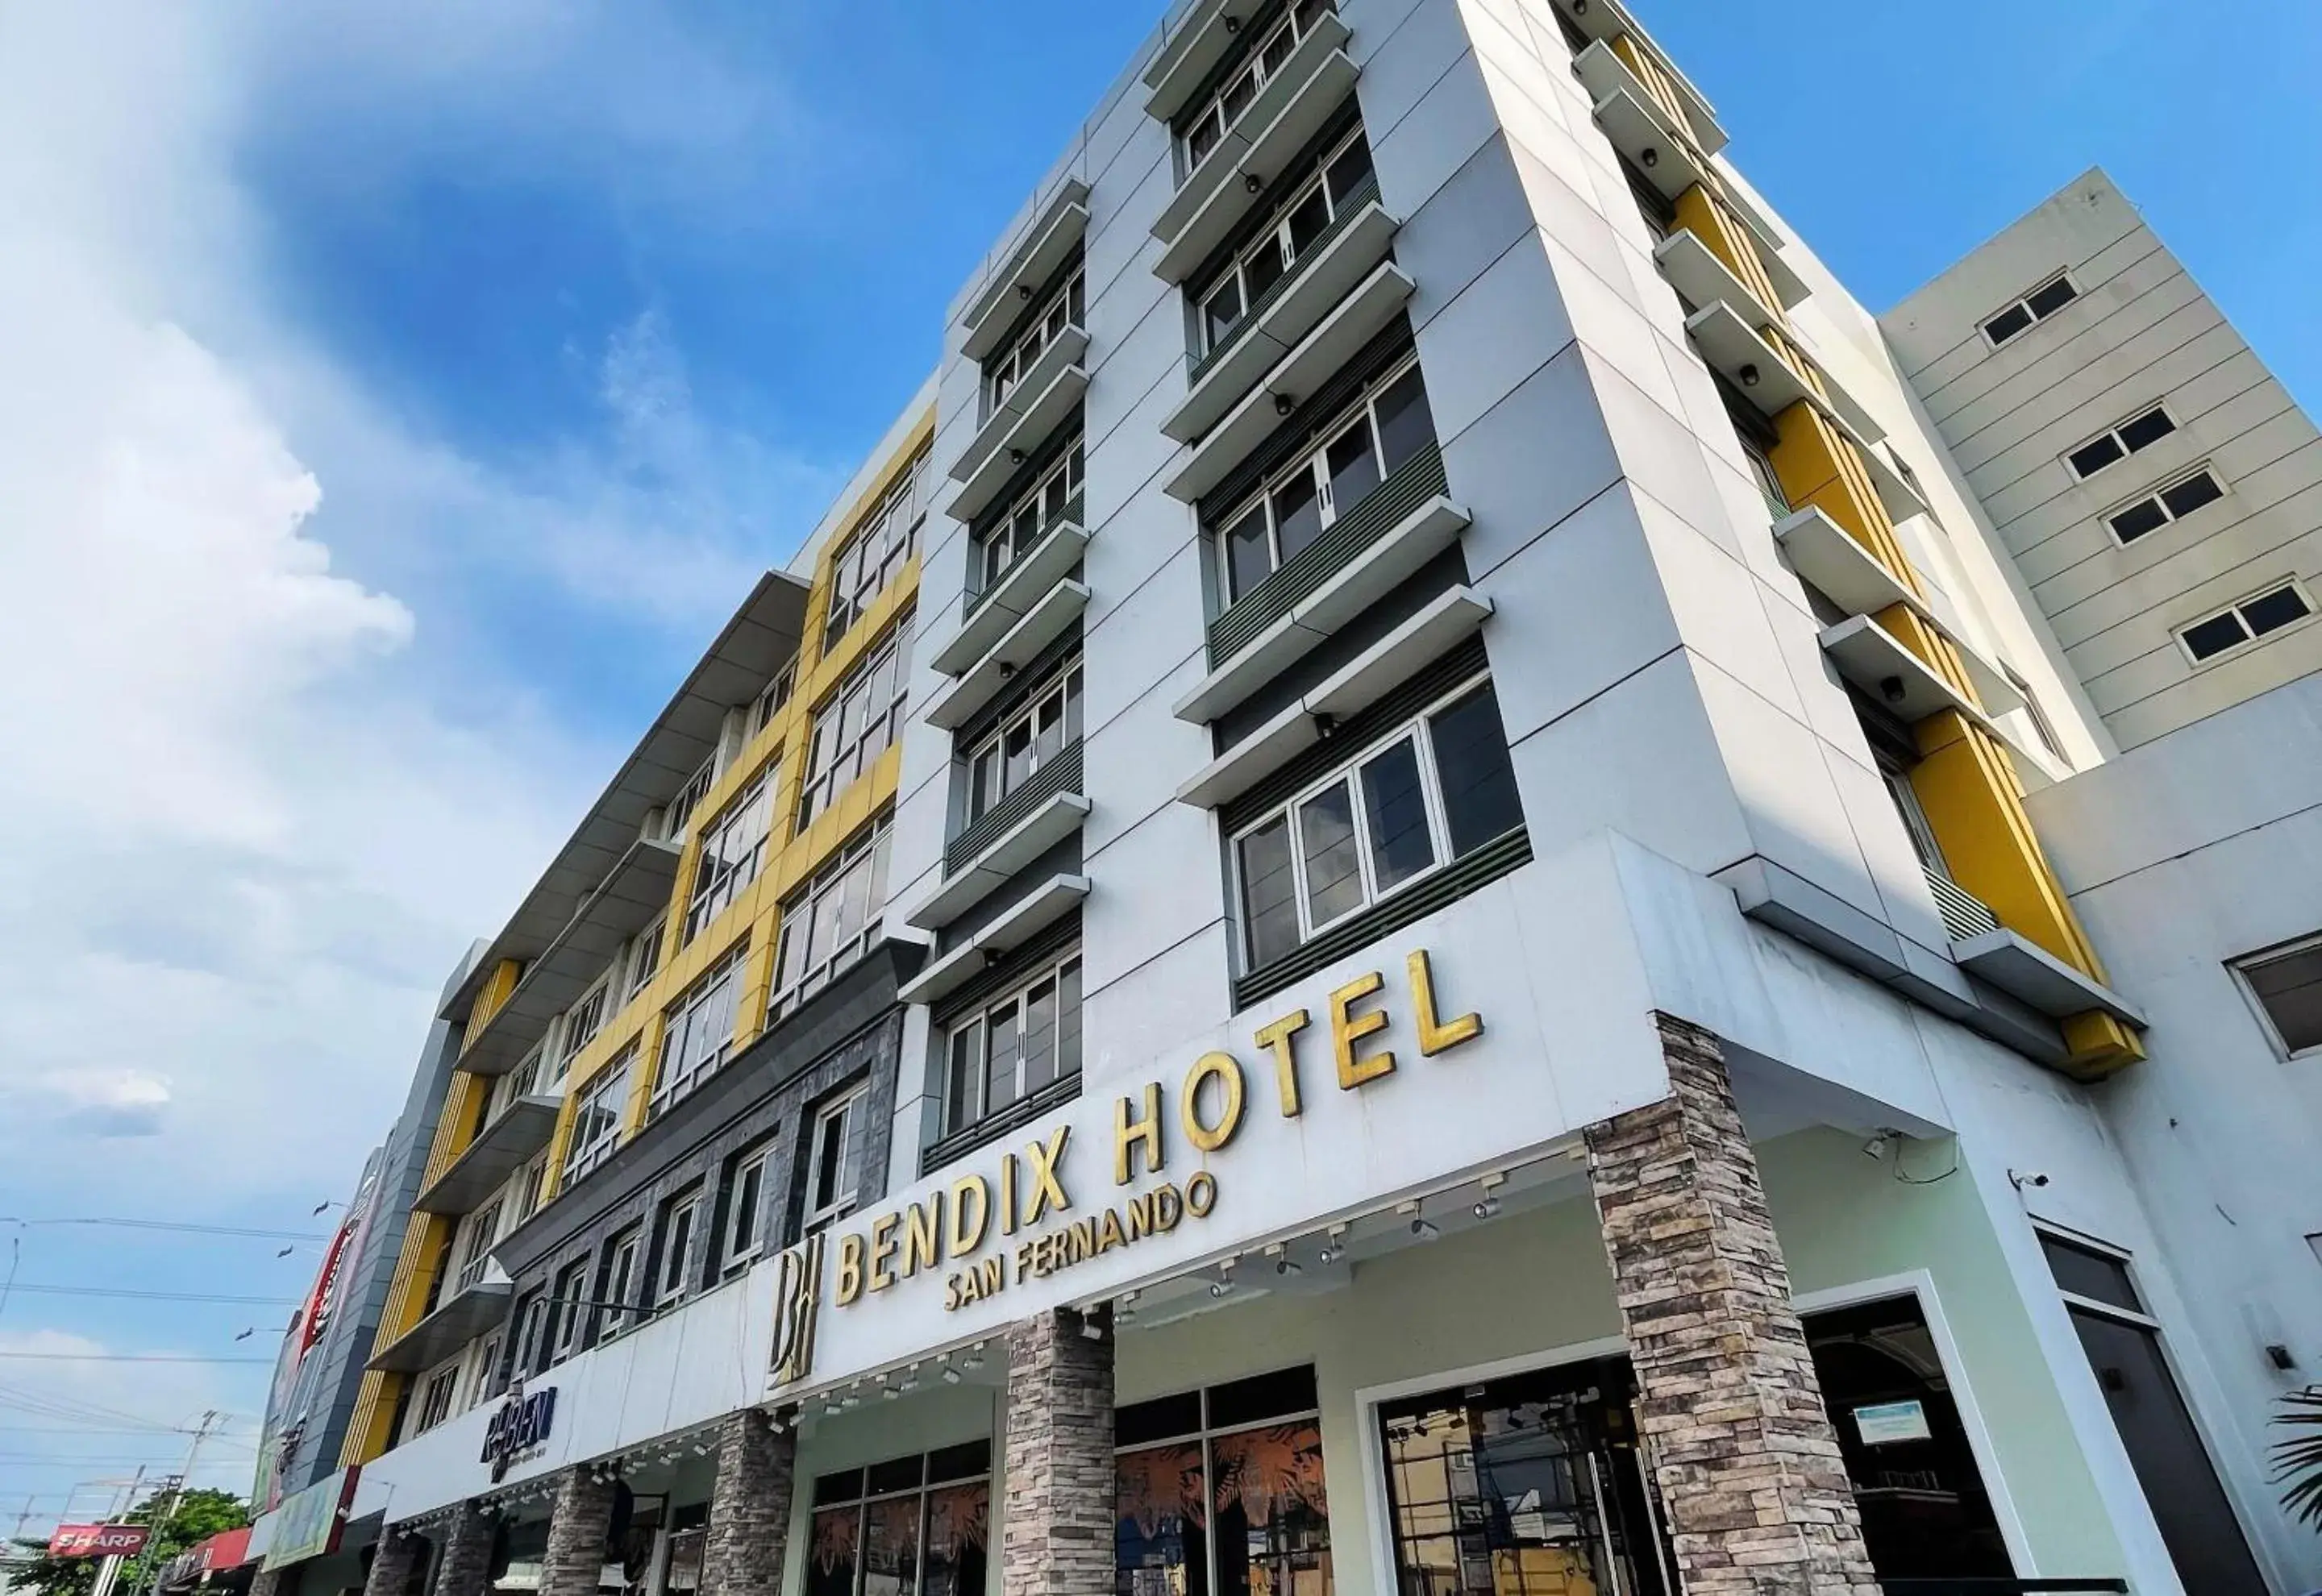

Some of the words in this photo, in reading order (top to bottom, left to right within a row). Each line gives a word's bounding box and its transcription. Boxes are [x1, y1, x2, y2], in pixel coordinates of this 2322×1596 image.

[835, 1125, 1073, 1307] BENDIX
[1114, 948, 1485, 1187] HOTEL
[944, 1253, 1004, 1311] SAN
[1015, 1170, 1219, 1285] FERNANDO
[57, 1534, 141, 1548] SHARP
